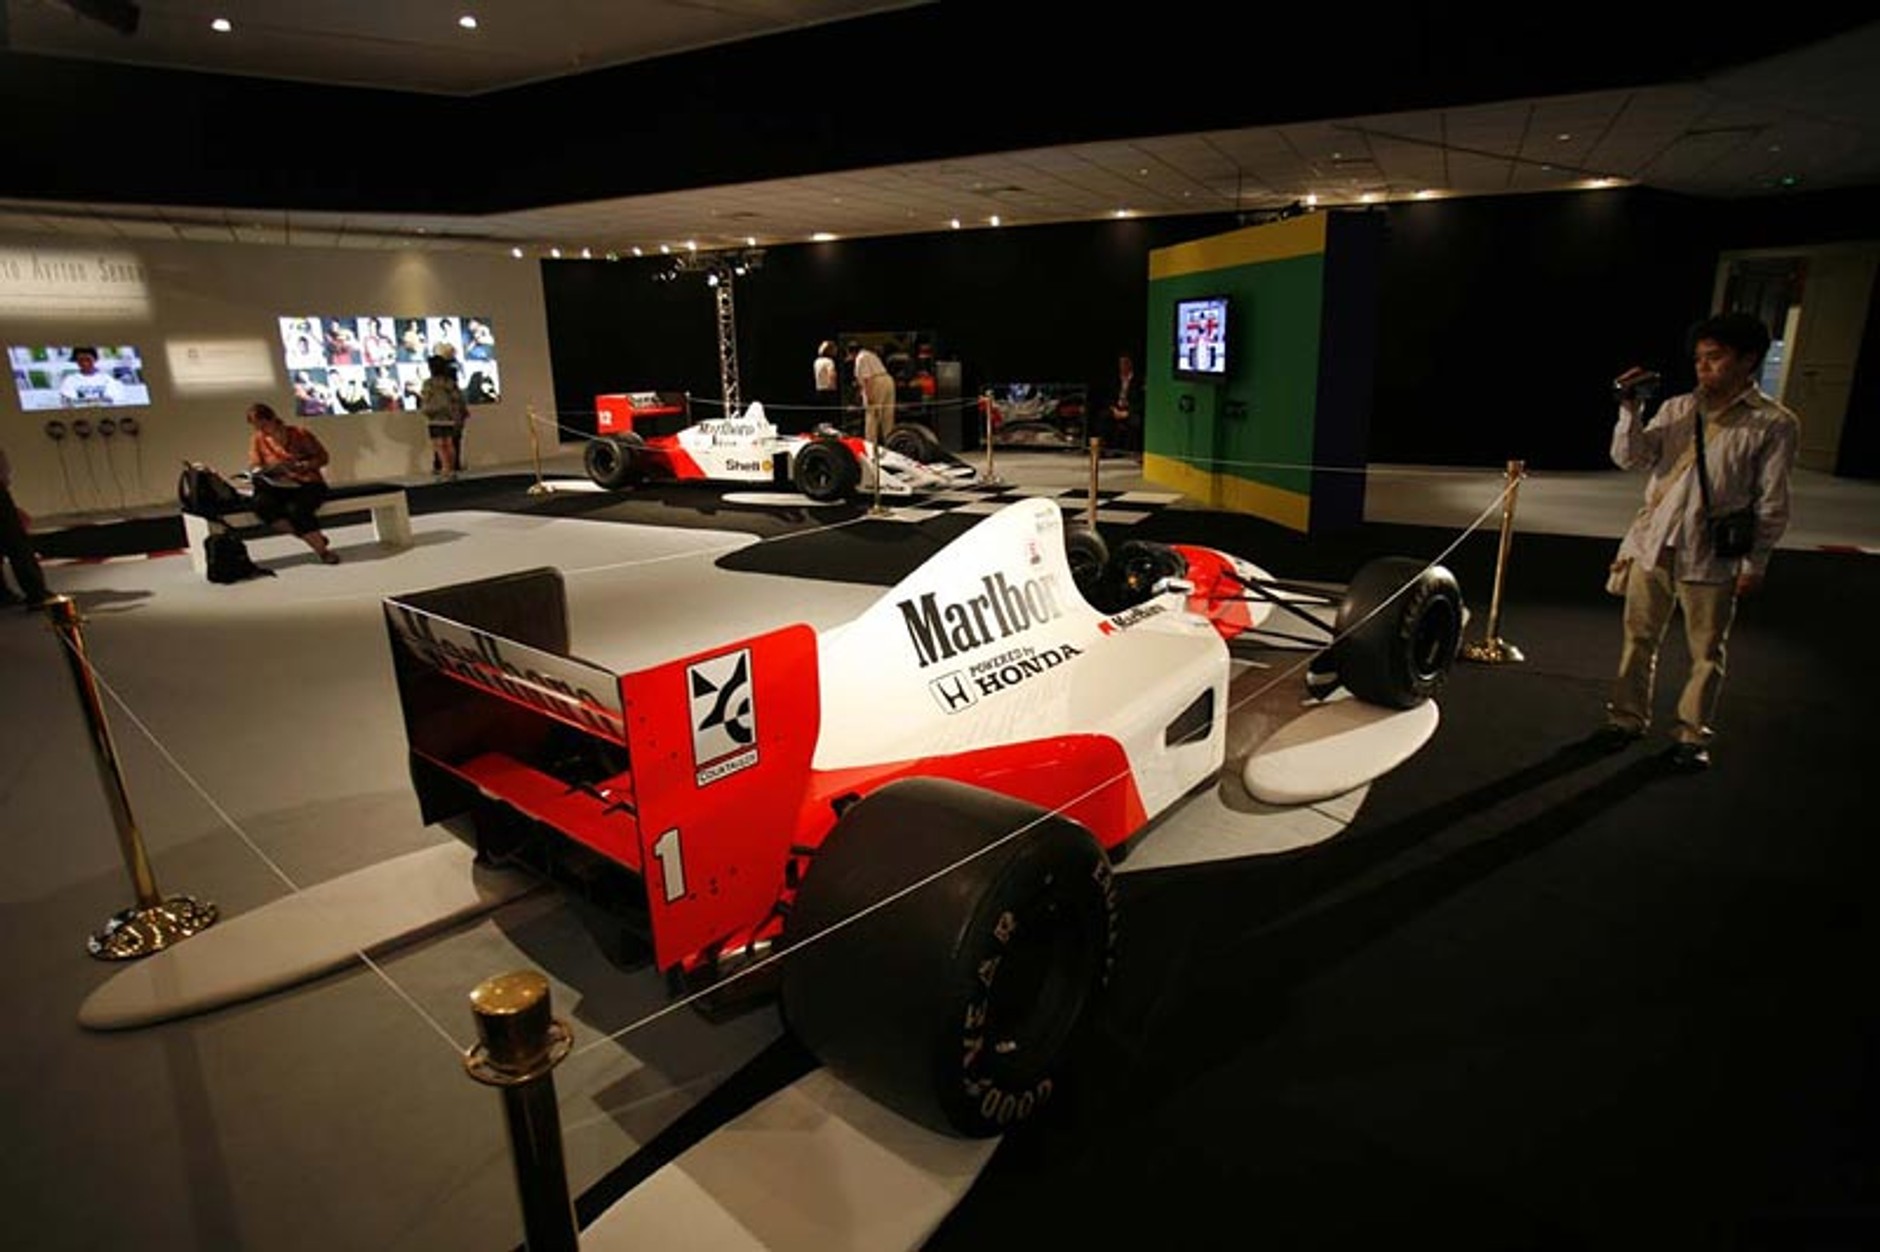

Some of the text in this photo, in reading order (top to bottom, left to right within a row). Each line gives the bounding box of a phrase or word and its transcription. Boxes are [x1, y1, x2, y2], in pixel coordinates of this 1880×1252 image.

[726, 458, 761, 472] Shell
[896, 571, 1064, 668] Marlbor
[969, 649, 1023, 677] POWERED
[974, 643, 1084, 697] HONDA
[654, 829, 687, 903] 1
